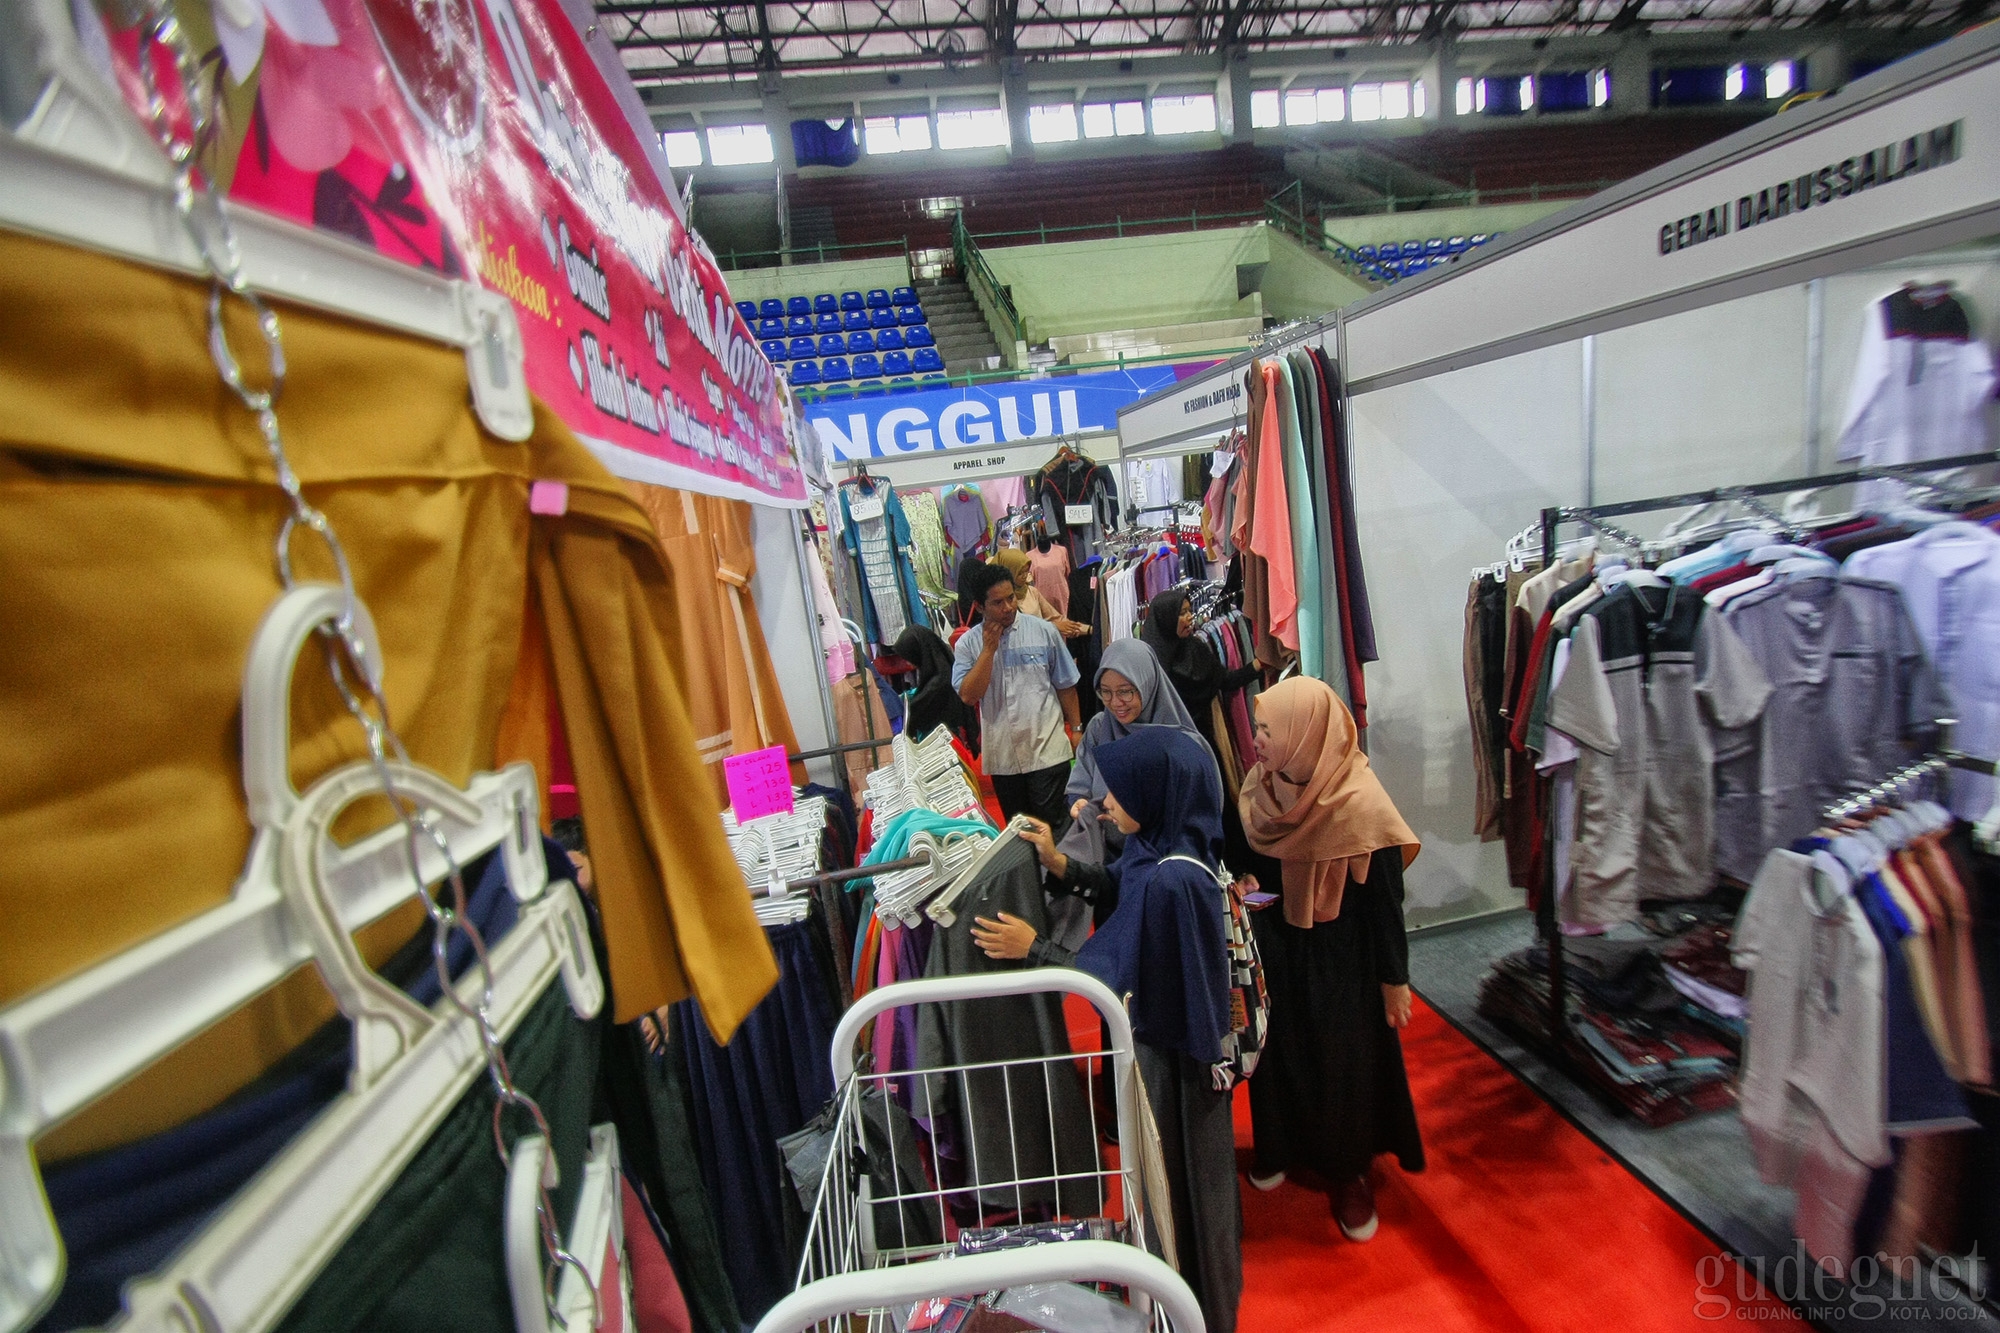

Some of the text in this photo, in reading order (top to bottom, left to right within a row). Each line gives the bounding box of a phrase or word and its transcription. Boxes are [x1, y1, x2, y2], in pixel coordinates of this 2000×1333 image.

[1658, 117, 1965, 257] GERAI DARUSSALAM
[1190, 395, 1208, 412] FASHION
[953, 456, 1006, 470] APPAREL SHOP
[1069, 509, 1088, 519] SALE
[760, 762, 782, 775] 125
[764, 777, 786, 789] 130
[767, 790, 789, 802] 135
